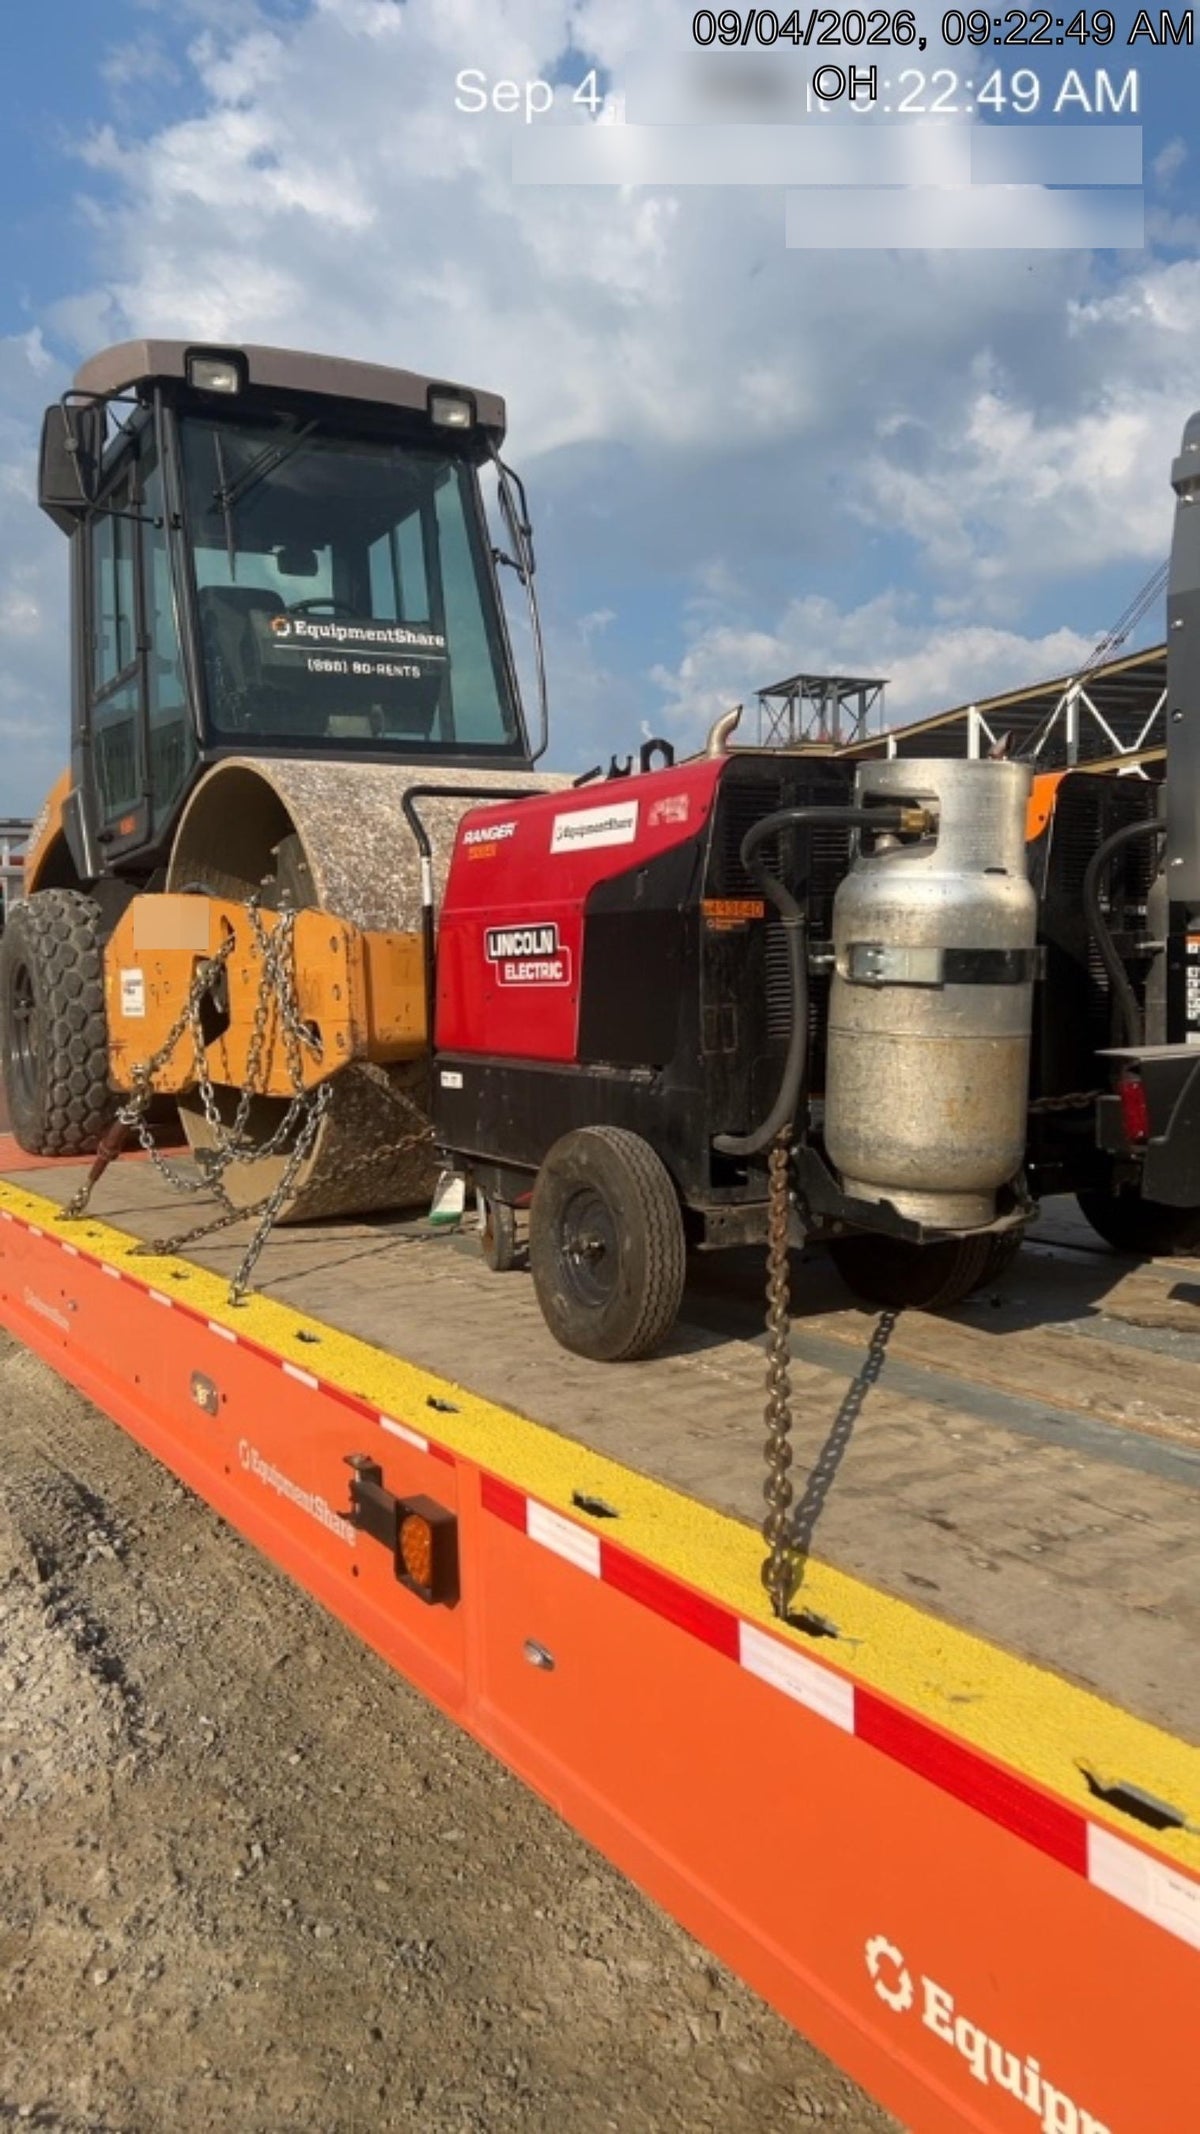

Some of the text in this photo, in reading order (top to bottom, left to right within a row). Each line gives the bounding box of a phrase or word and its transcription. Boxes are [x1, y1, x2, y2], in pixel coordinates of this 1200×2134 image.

[293, 620, 445, 648] EquipmentShare
[462, 821, 519, 845] RANGER
[489, 929, 554, 957] LINCOLN
[505, 962, 563, 980] ELECTRIC
